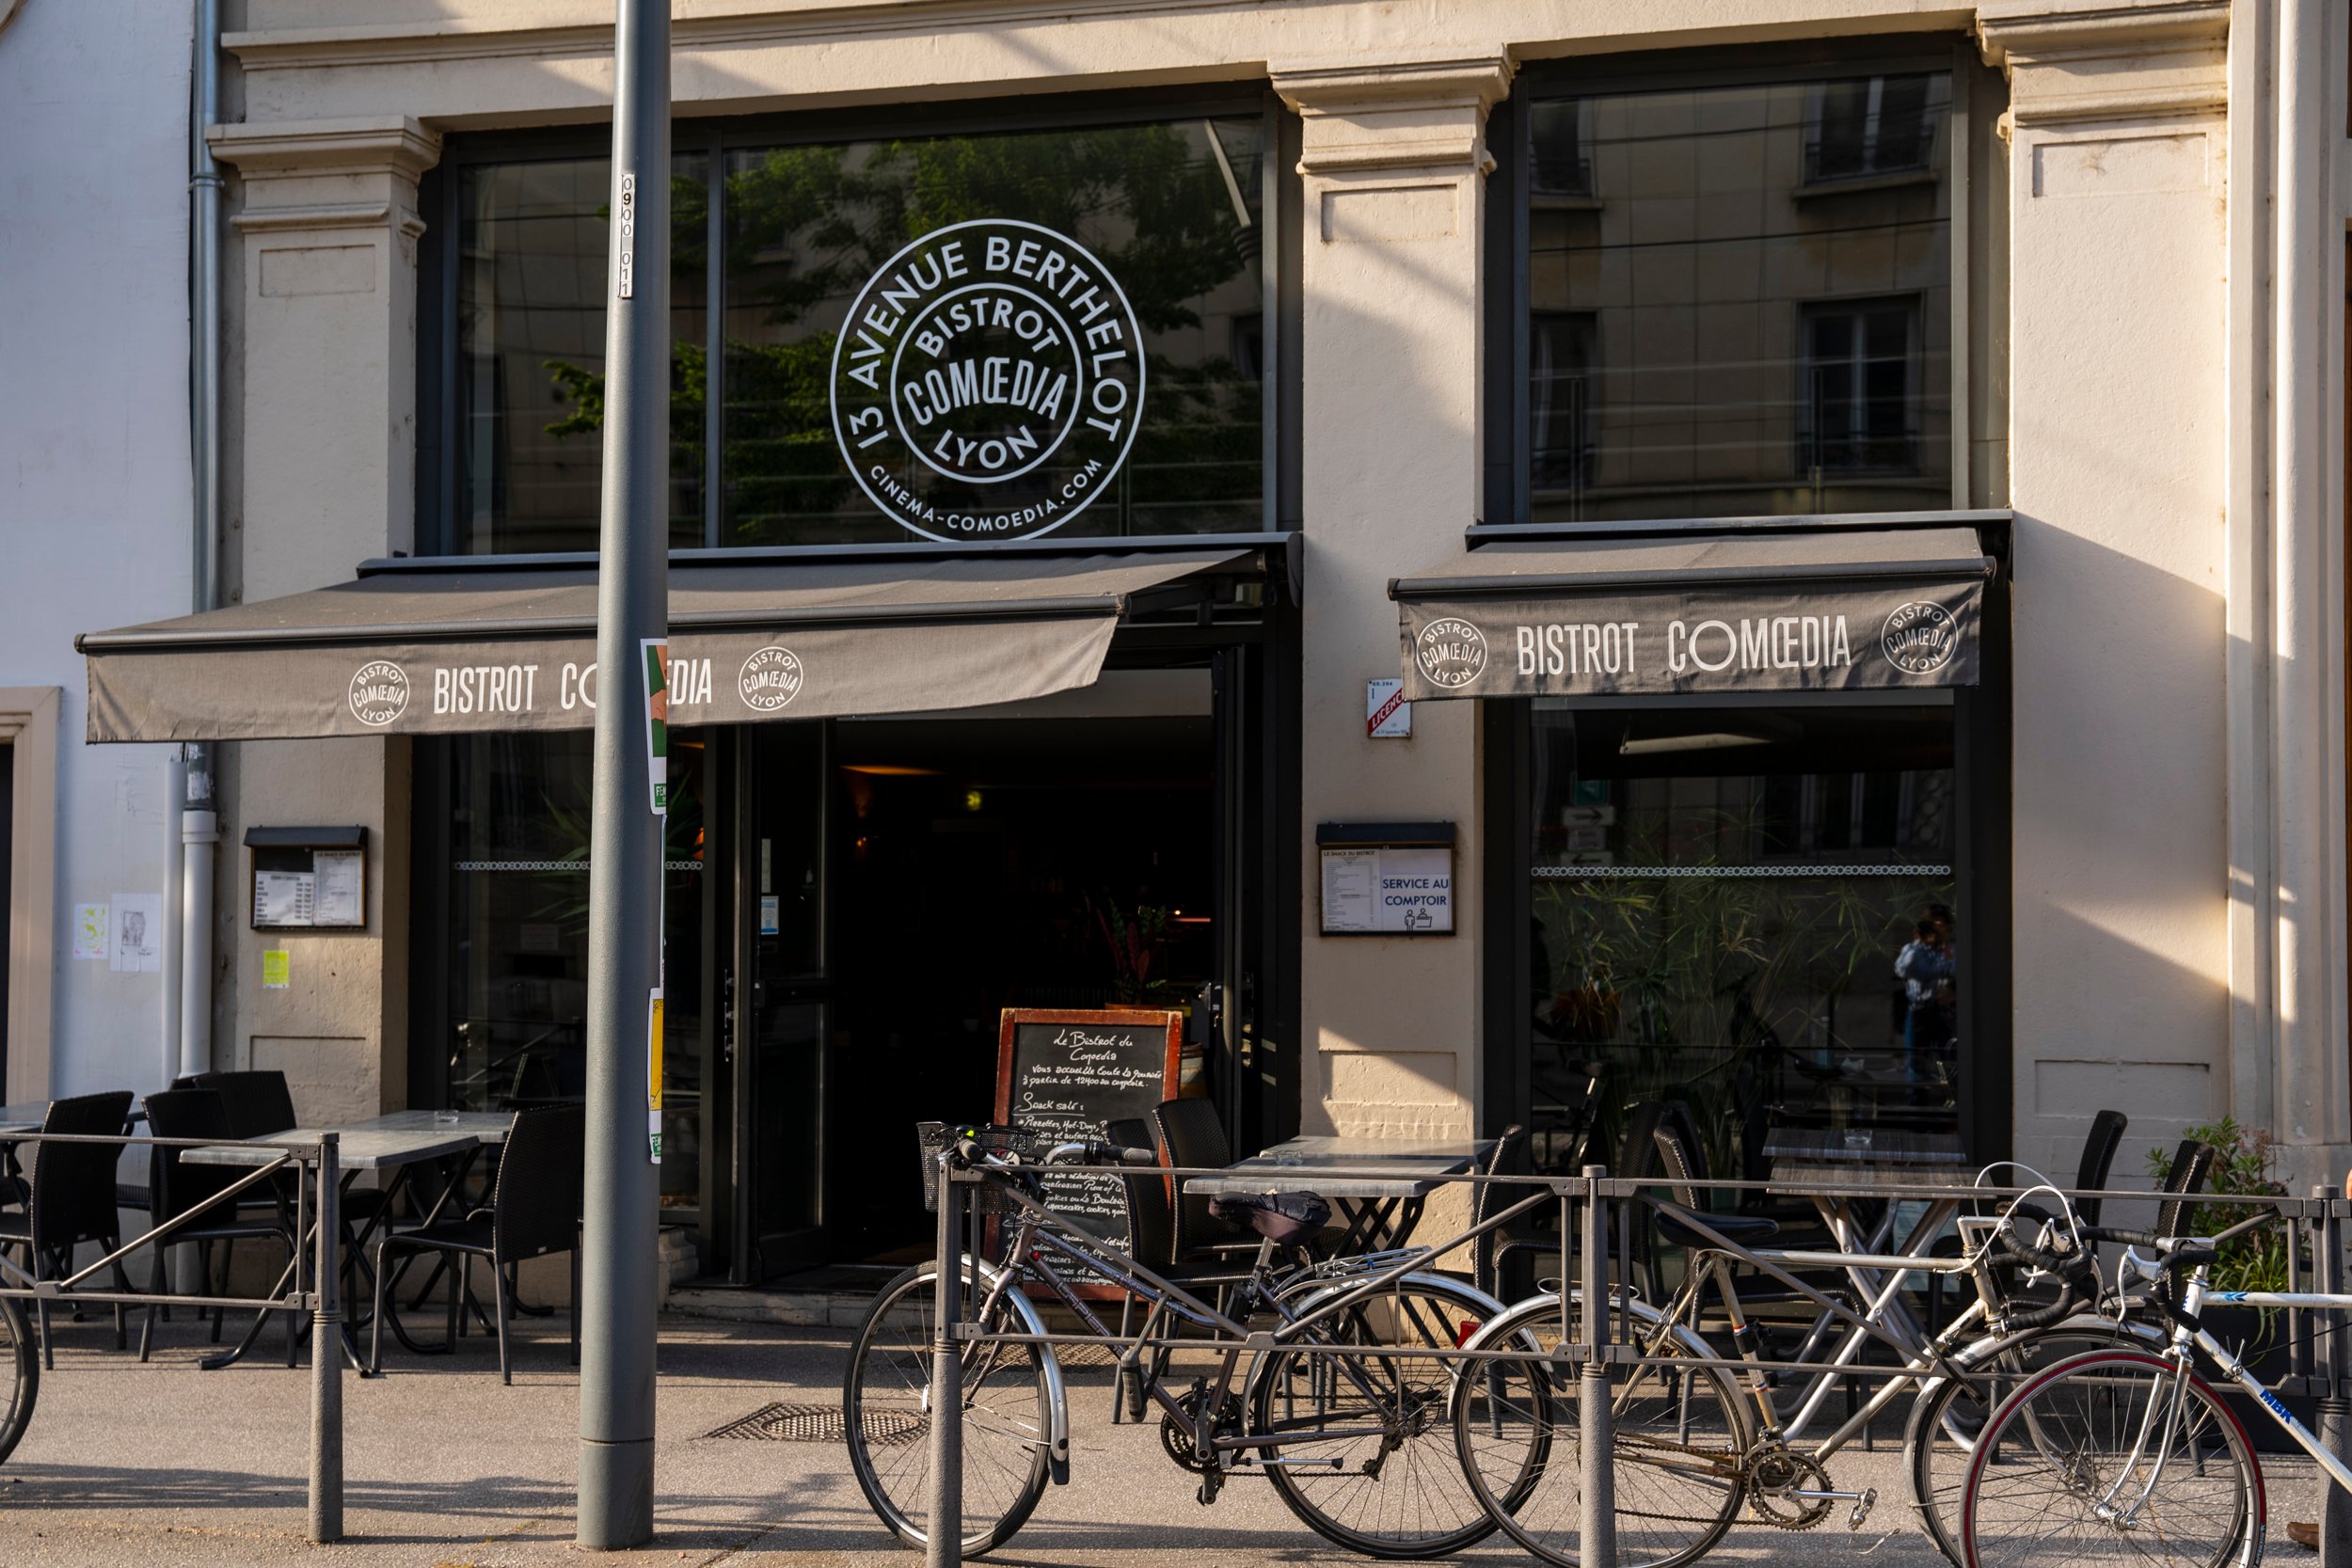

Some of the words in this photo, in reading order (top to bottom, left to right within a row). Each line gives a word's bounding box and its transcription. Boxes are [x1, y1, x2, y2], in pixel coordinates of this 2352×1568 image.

[848, 241, 969, 390] AVENUE
[914, 297, 1061, 358] BISTROT
[985, 236, 1128, 443] BERTHELOT
[849, 406, 889, 450] 13
[933, 425, 1039, 469] LYON
[870, 458, 1103, 532] CINEMA-COMOEDIA.COM
[1891, 605, 1950, 628] BISTROT
[1424, 623, 1479, 643] BISTROT
[1516, 622, 1639, 675] BISTROT
[747, 651, 797, 672] BISTROT
[1899, 653, 1941, 670] LYON
[357, 665, 403, 685] BISTROT
[1434, 667, 1471, 684] LYON
[434, 665, 538, 714] BISTROT
[751, 692, 786, 707] LYON
[361, 706, 395, 721] LYON
[1372, 689, 1404, 729] LICENC
[1382, 879, 1429, 889] SERVICE
[1433, 879, 1449, 889] AU
[1385, 895, 1447, 906] COMPTOIR
[1069, 1031, 1117, 1048] Bistrot
[1119, 1035, 1133, 1047] du
[1060, 1075, 1072, 1085] de
[2259, 1389, 2294, 1425] MBK
